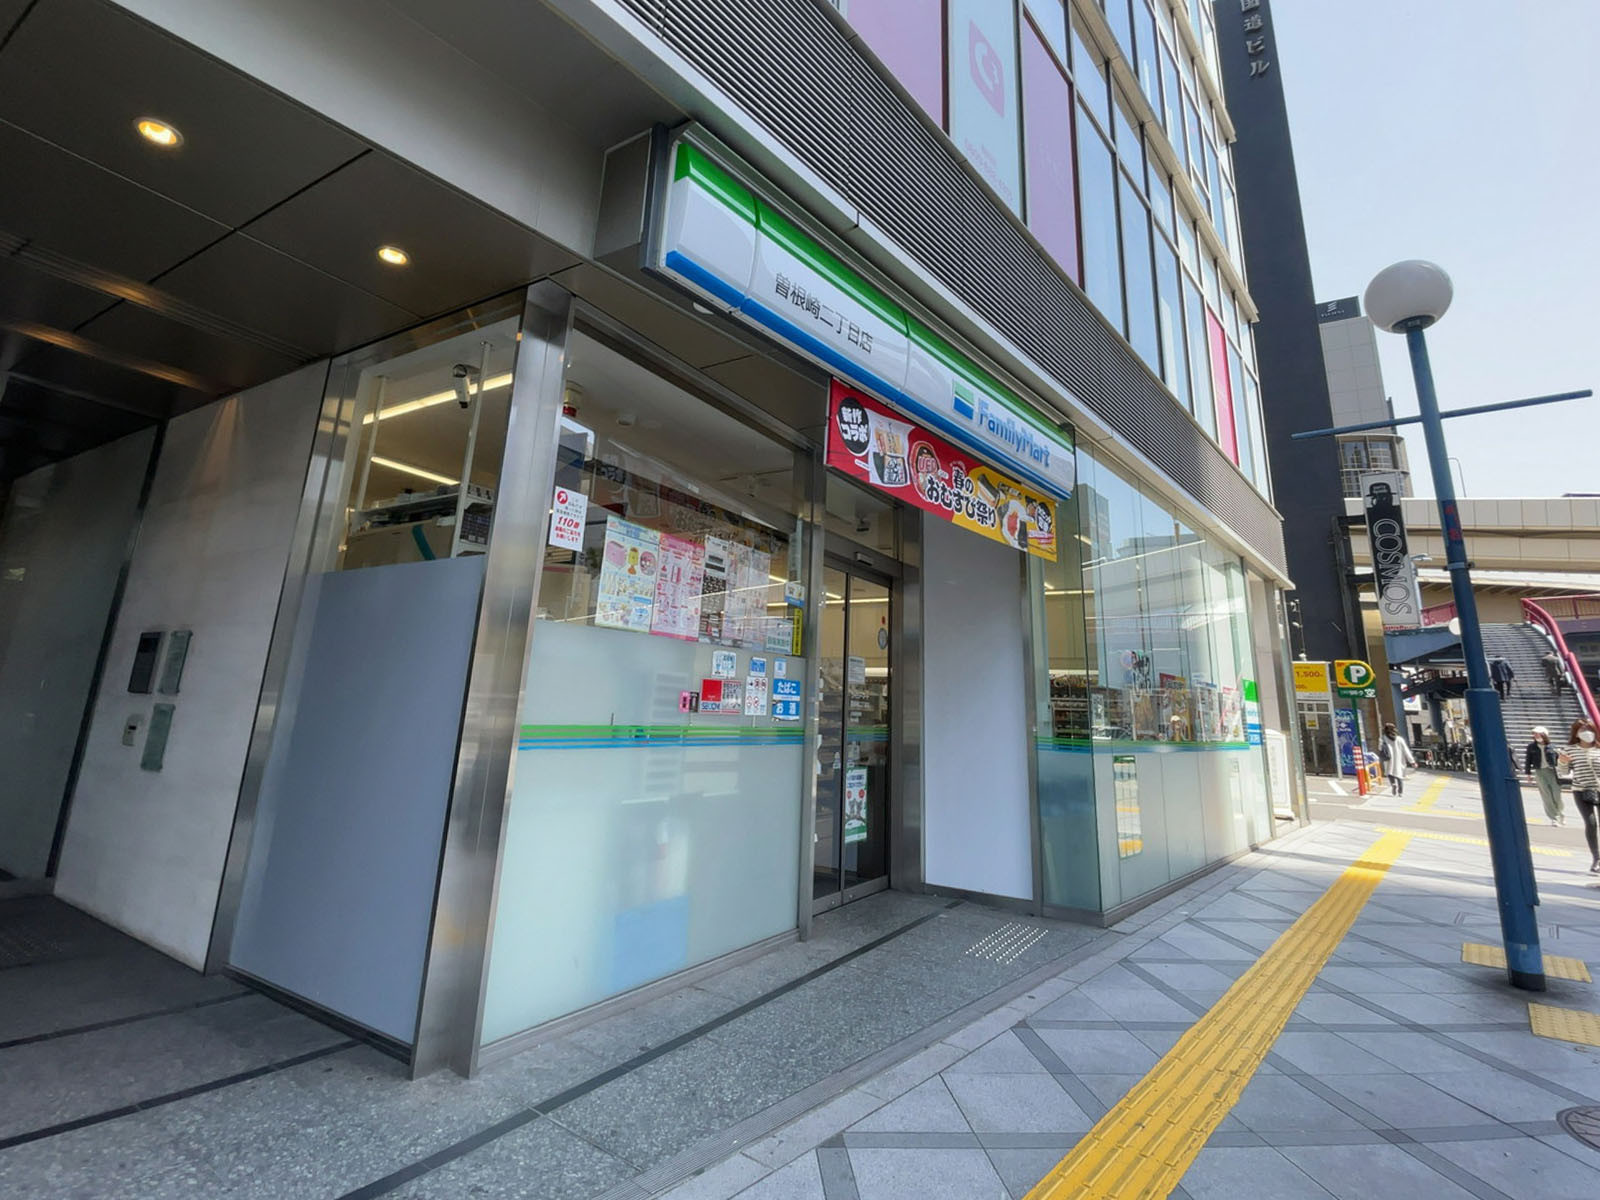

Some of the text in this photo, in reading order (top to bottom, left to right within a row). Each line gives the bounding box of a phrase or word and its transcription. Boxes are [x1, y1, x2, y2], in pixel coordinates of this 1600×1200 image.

[775, 273, 873, 353] 曽根崎二丁目店
[841, 405, 863, 425] 新作
[840, 423, 868, 444] コラボ
[978, 400, 1050, 467] FamilyMart
[952, 468, 974, 494] 春の
[927, 476, 997, 527] おむすび祭り
[1372, 518, 1412, 616] COSMOS
[1349, 665, 1367, 683] P
[777, 681, 797, 694] たばこ
